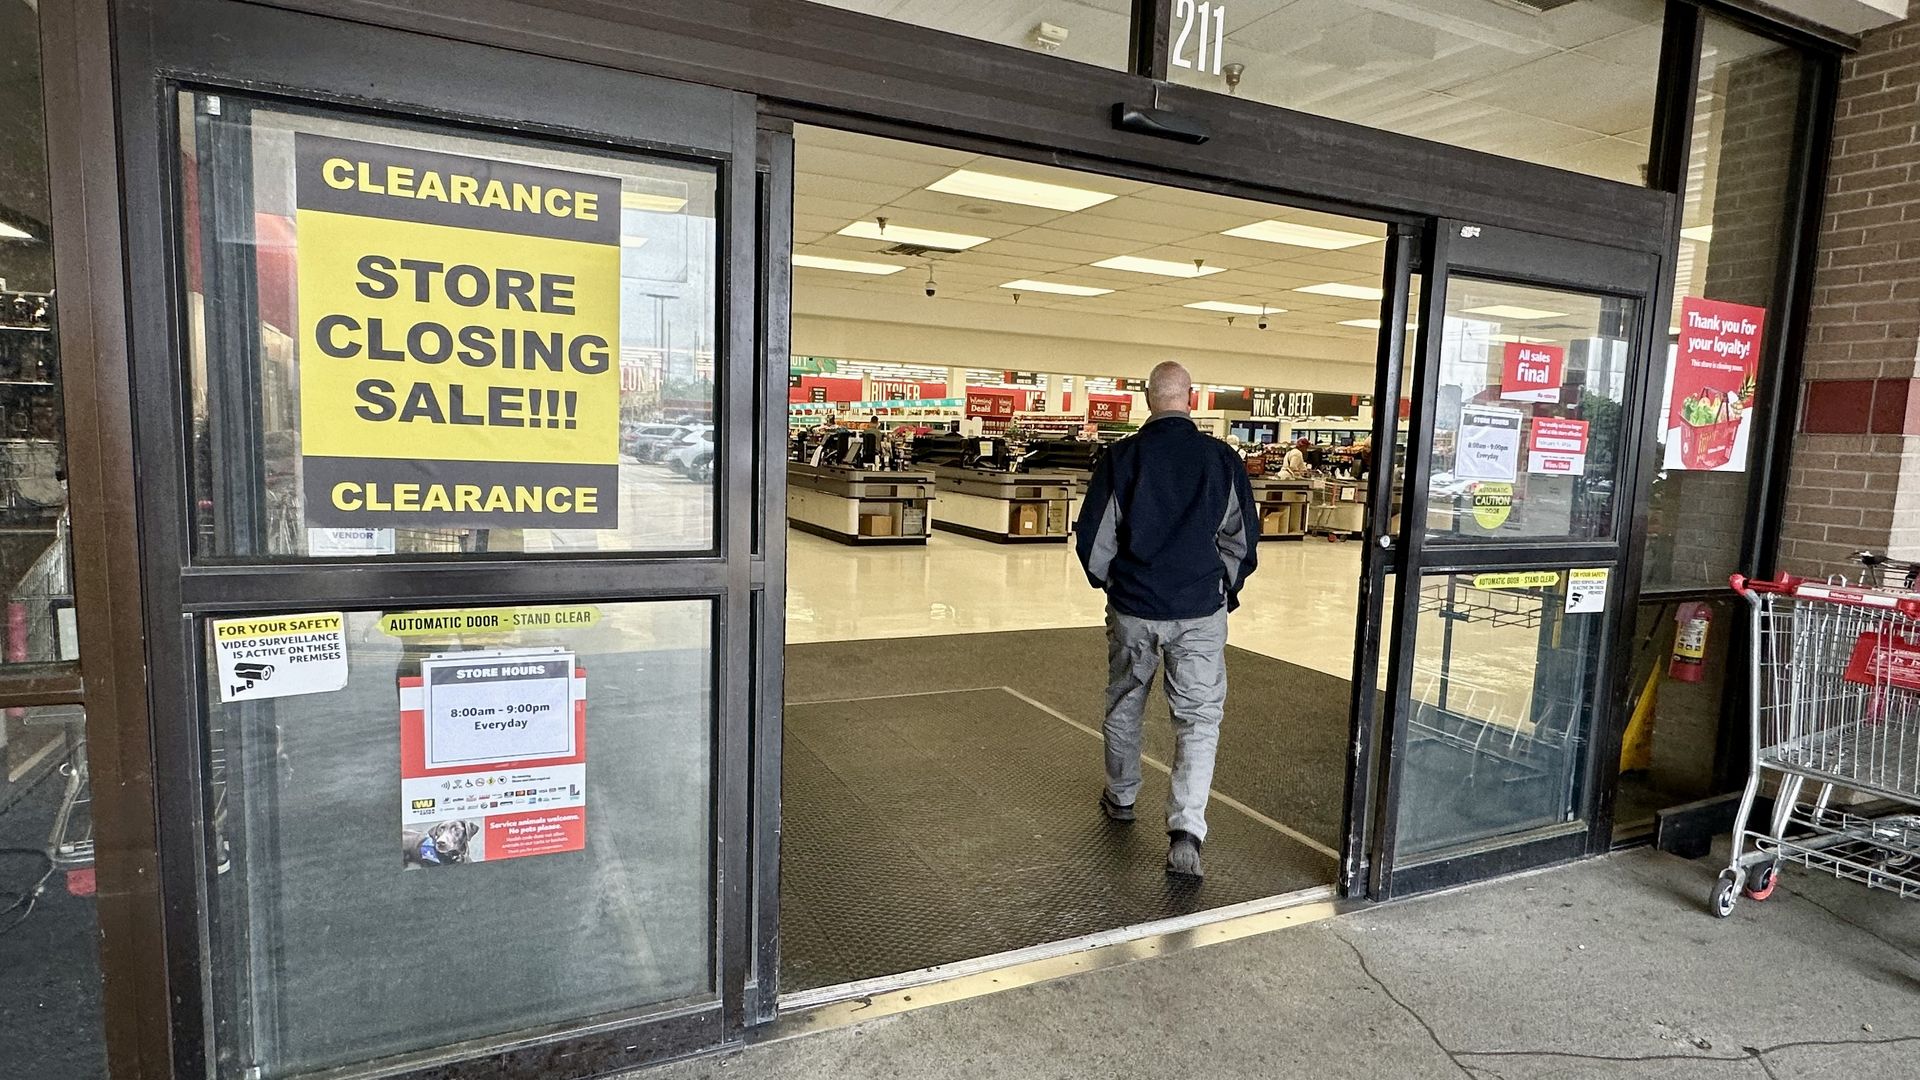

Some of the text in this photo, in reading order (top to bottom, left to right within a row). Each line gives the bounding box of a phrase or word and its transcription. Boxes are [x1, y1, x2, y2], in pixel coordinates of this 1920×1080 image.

[1172, 0, 1225, 76] 211
[322, 158, 599, 222] CLEARANCE
[356, 255, 576, 316] STORE
[1687, 311, 1757, 336] Thank you for
[315, 314, 610, 375] CLOSING
[1687, 336, 1751, 360] your loyalty!
[1518, 349, 1550, 363] All sales
[1517, 362, 1550, 384] final
[1691, 359, 1700, 367] This
[1700, 361, 1712, 369] store
[1716, 363, 1732, 372] closing
[871, 381, 920, 401] BUTCHER
[354, 378, 578, 430] SALE!!!
[970, 397, 993, 405] Winning
[971, 404, 991, 412] Deals
[1253, 393, 1276, 417] WINE
[1277, 393, 1286, 416] &
[1288, 392, 1314, 417] BEER
[1092, 409, 1113, 417] YEARS
[1490, 444, 1508, 452] 9:00pm
[1476, 451, 1499, 461] Everyday
[331, 481, 599, 514] CLEARANCE
[1475, 495, 1511, 506] CAUTION
[332, 531, 374, 540] VENDOR
[1479, 577, 1506, 586] AUTOMATIC
[1507, 576, 1520, 585] DOOR
[1524, 576, 1539, 584] STAND
[1540, 575, 1555, 583] CLEAR
[218, 618, 340, 636] FOR YOUR SAFETY
[390, 616, 462, 632] AUTOMATIC
[467, 614, 499, 628] DOOR
[513, 613, 551, 626] STAND
[555, 611, 591, 623] CLEAR
[222, 632, 339, 650] VIDEO SURVEILLANCE
[233, 642, 340, 659] IS ACTIVE ON THESE
[289, 652, 341, 664] PREMISES
[456, 665, 546, 679] STORE HOURS
[450, 707, 496, 718] 8:00am
[506, 703, 550, 714] 9:00pm
[474, 719, 528, 731] Everyday
[490, 814, 580, 829] Service animals welcome.
[520, 825, 537, 834] pets
[537, 824, 562, 833] please.
